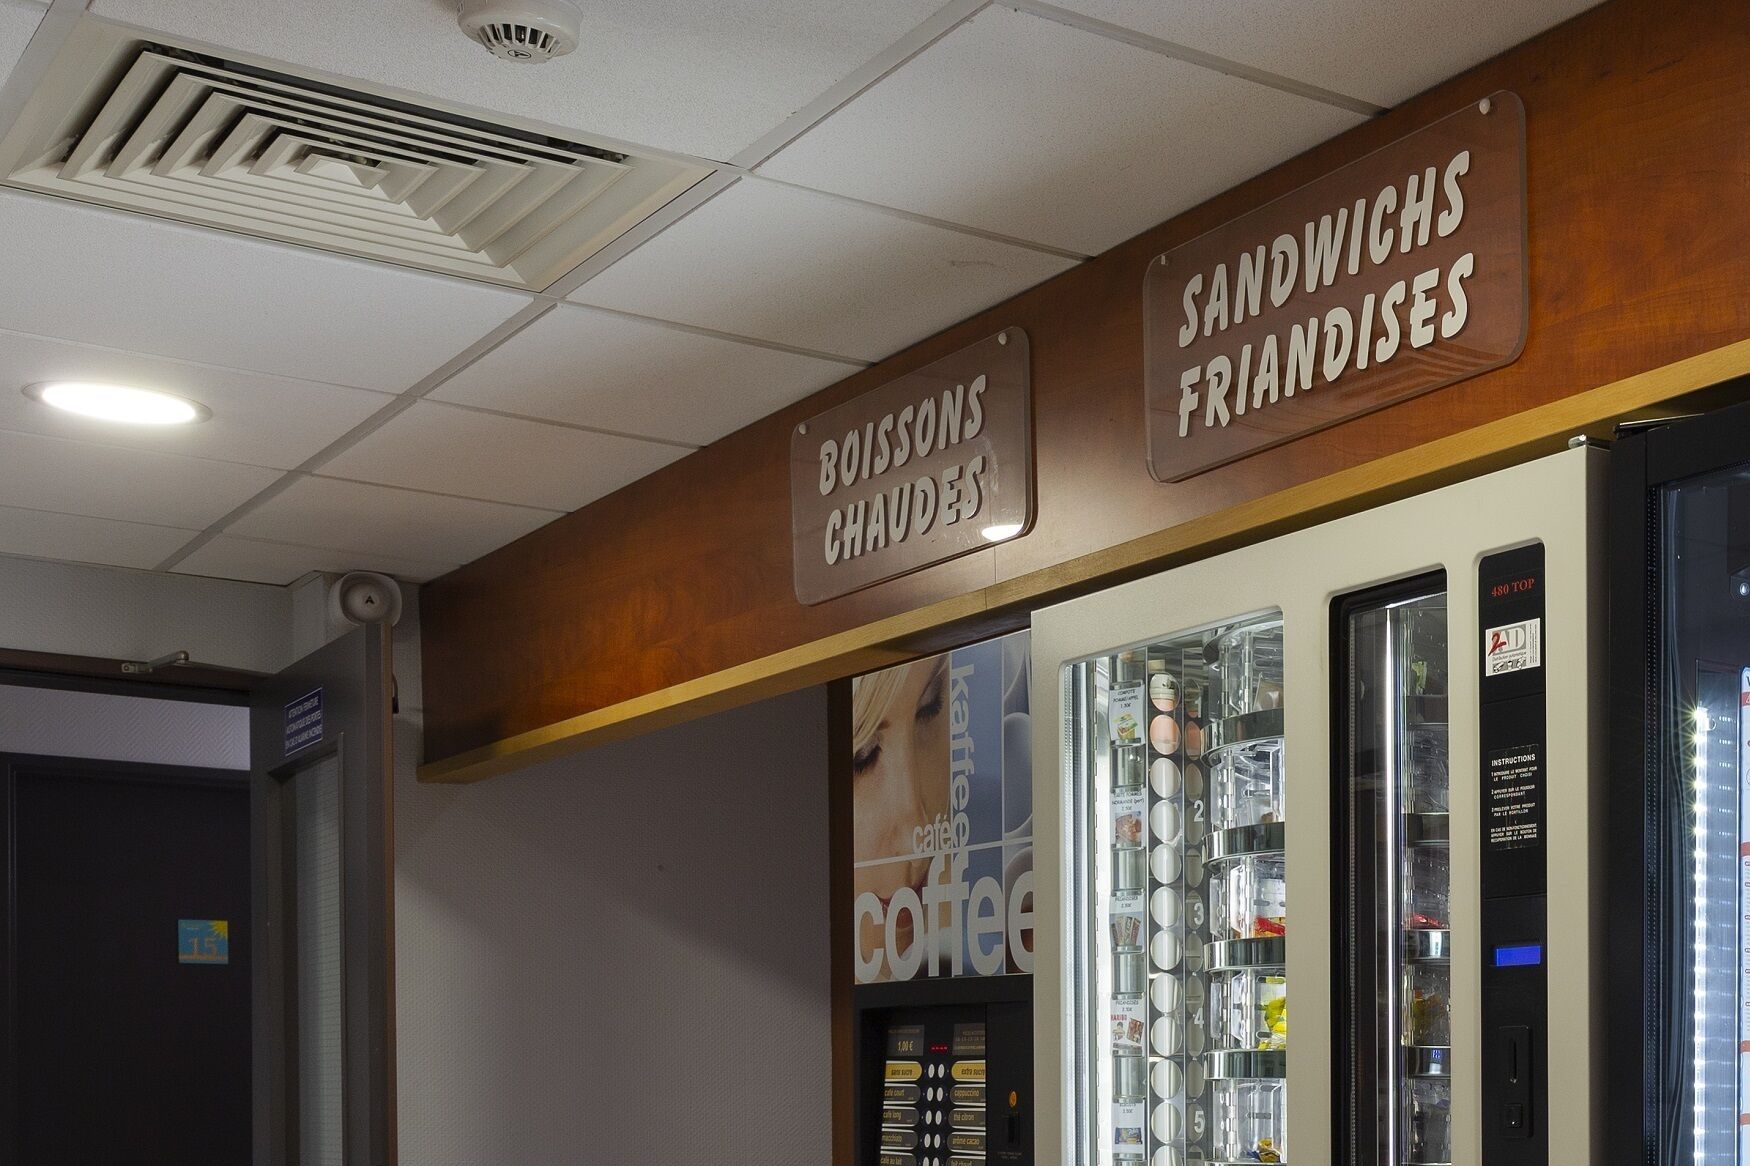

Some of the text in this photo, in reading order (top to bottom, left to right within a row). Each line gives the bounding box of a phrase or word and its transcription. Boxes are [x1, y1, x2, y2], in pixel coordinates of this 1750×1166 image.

[1178, 150, 1470, 348] SANDWICHS
[1178, 252, 1474, 438] FRIANDISES
[820, 374, 986, 497] BOISSONS
[824, 456, 984, 566] CHAUDES
[1492, 578, 1535, 597] 480 TOP
[951, 664, 974, 849] kaffee
[1492, 754, 1535, 766] INSTRUCTIONS
[912, 812, 951, 853] café
[854, 852, 1034, 984] coffee
[1194, 1111, 1204, 1133] 5
